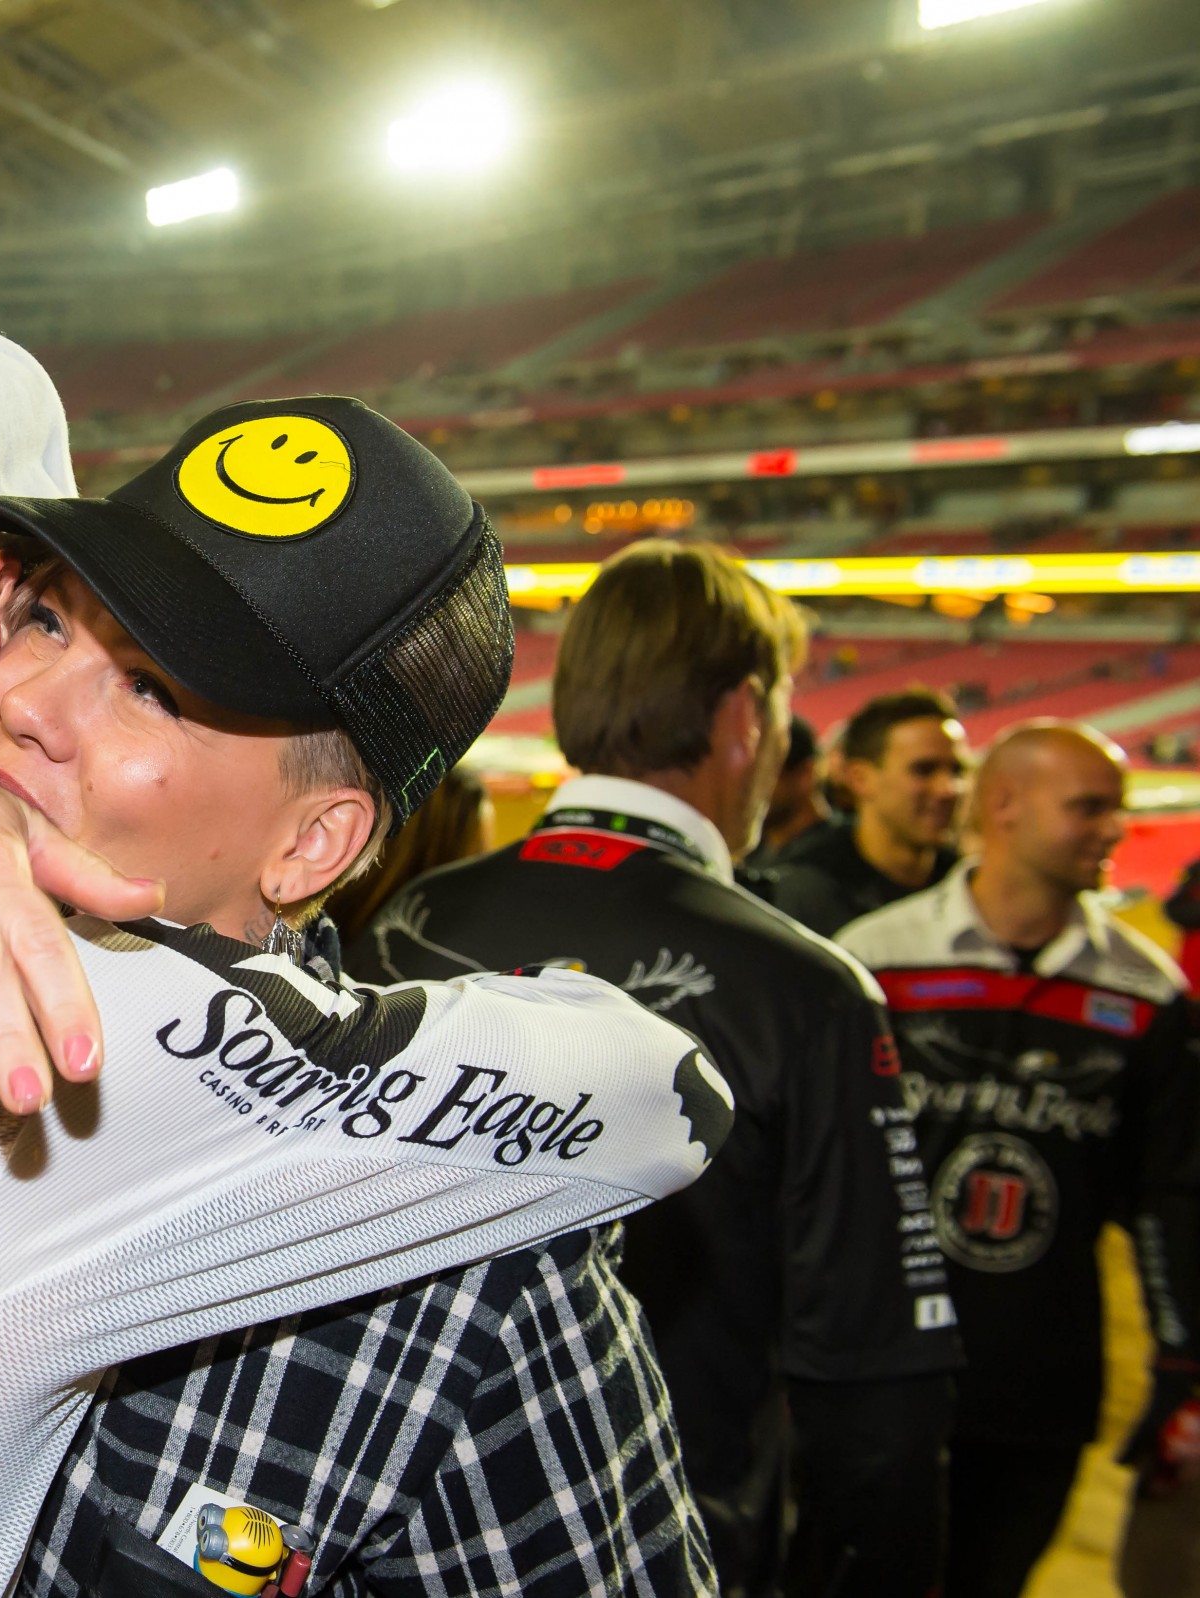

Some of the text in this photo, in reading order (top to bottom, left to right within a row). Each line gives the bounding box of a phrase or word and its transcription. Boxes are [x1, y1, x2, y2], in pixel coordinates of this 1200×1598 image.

[198, 1069, 253, 1116] CASINO
[265, 1116, 327, 1138] RRT
[397, 1064, 604, 1166] Eagle
